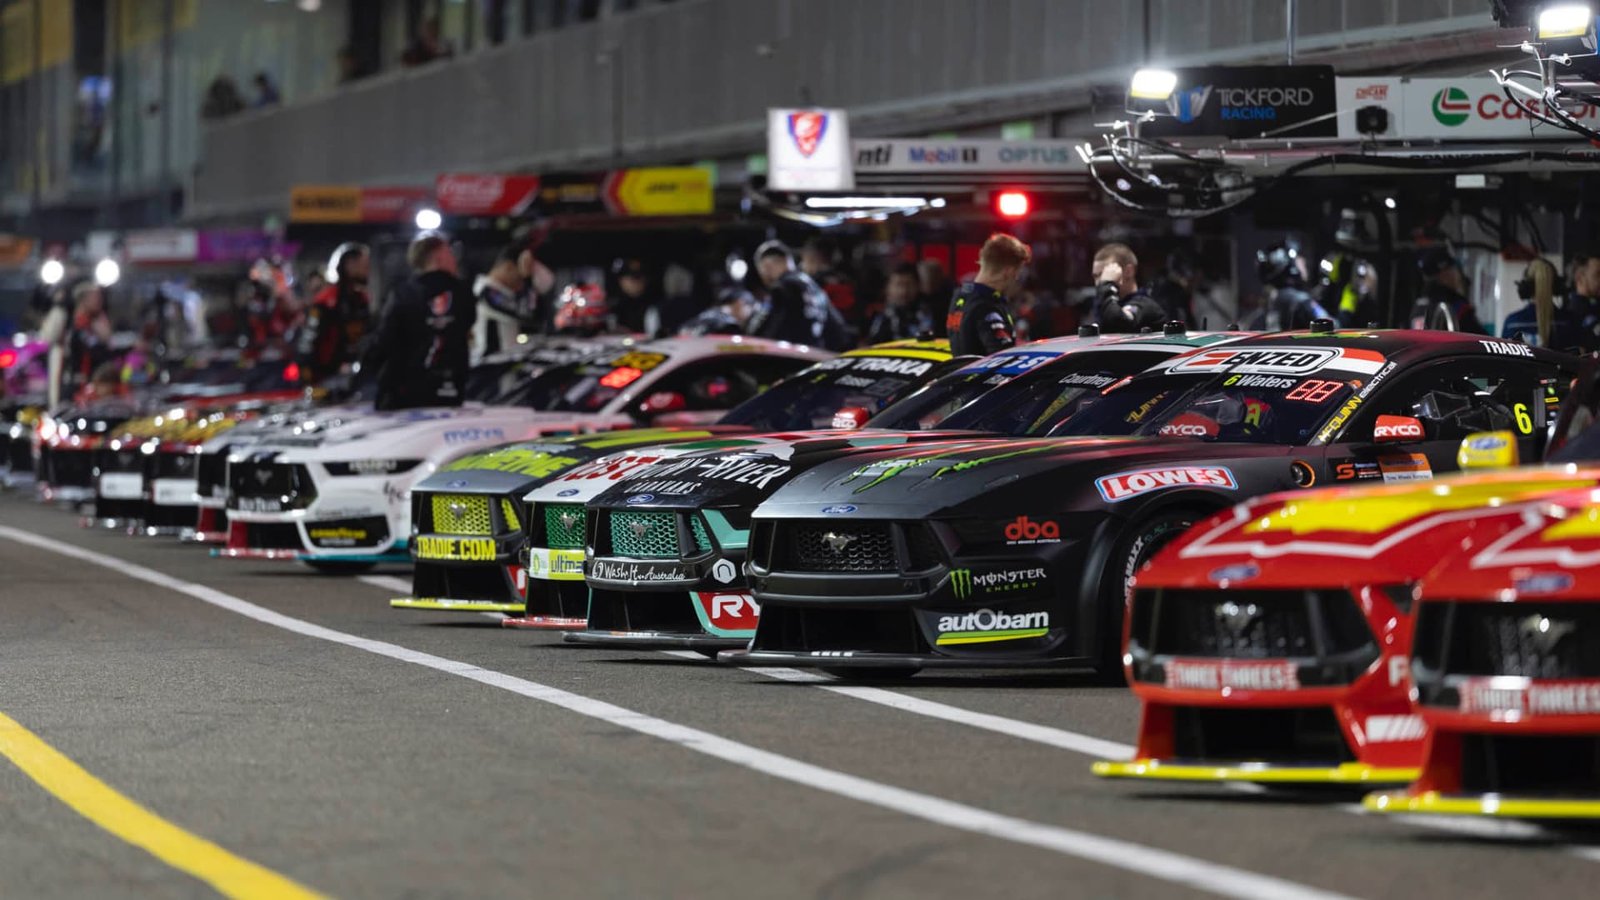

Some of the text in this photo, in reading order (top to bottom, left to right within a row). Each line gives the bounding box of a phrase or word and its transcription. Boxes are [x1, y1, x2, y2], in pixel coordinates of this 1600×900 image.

[1215, 87, 1314, 107] TICKFORD
[1220, 107, 1277, 120] RACING
[908, 146, 958, 164] Mobil
[998, 146, 1069, 163] OPTUS
[1478, 340, 1535, 358] TRADIE
[1222, 350, 1324, 368] ENZED
[1058, 372, 1117, 389] Courtney
[1224, 374, 1297, 390] 6 Waters
[1359, 361, 1398, 399] electrical
[1513, 402, 1533, 435] 6
[1373, 424, 1422, 438] RYCO
[1107, 469, 1228, 498] LOWES
[1004, 515, 1061, 541] dba
[416, 535, 497, 562] TRADIE.COM
[973, 567, 1047, 587] MONSTER
[985, 582, 1038, 593] ENERGY
